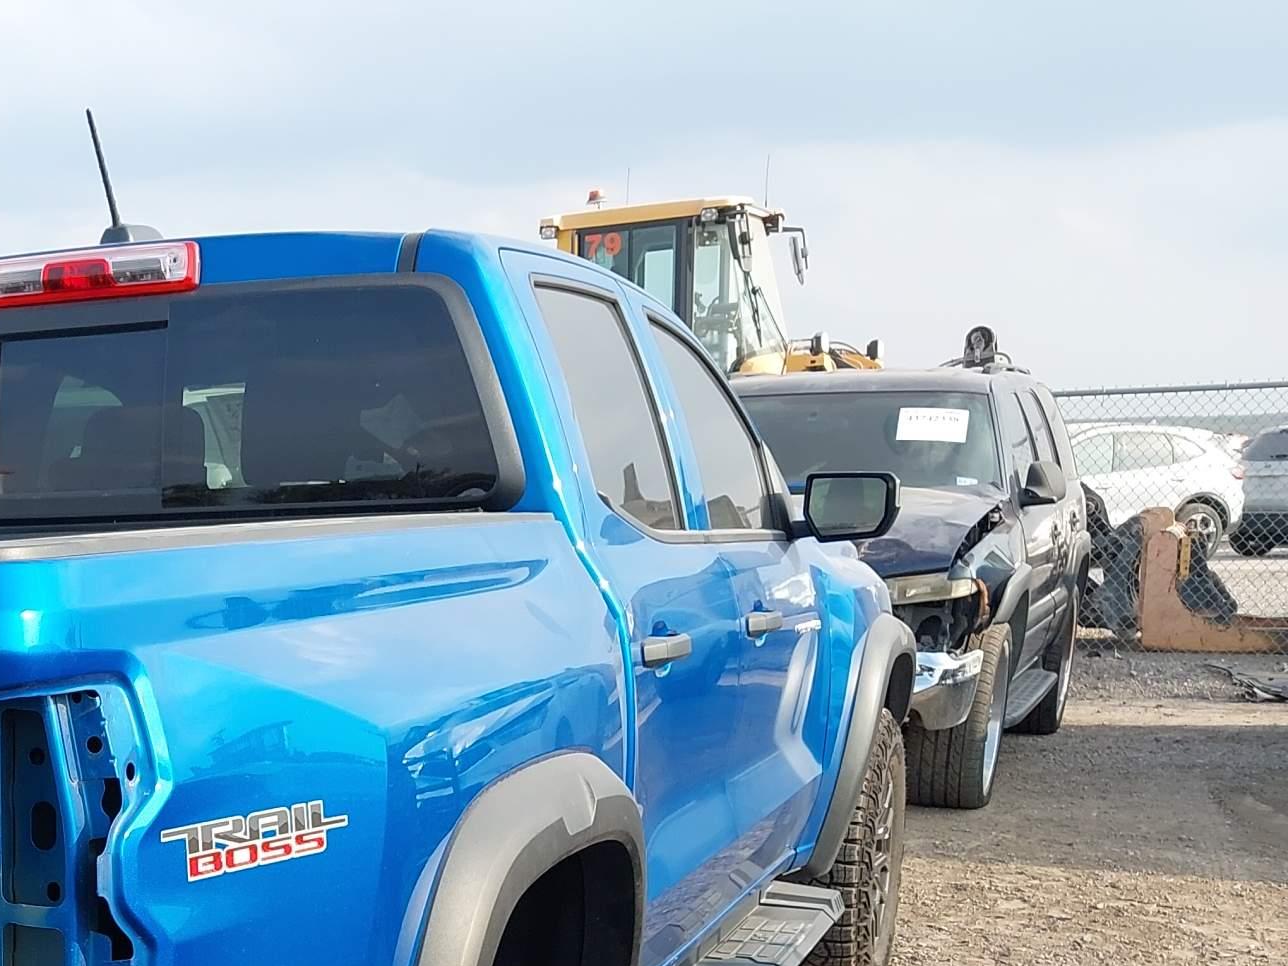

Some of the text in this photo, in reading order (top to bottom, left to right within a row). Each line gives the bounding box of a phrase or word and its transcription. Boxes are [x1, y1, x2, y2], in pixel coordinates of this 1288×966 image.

[584, 232, 621, 257] 79
[162, 802, 347, 855] TRAIL
[189, 830, 324, 878] BOSS
